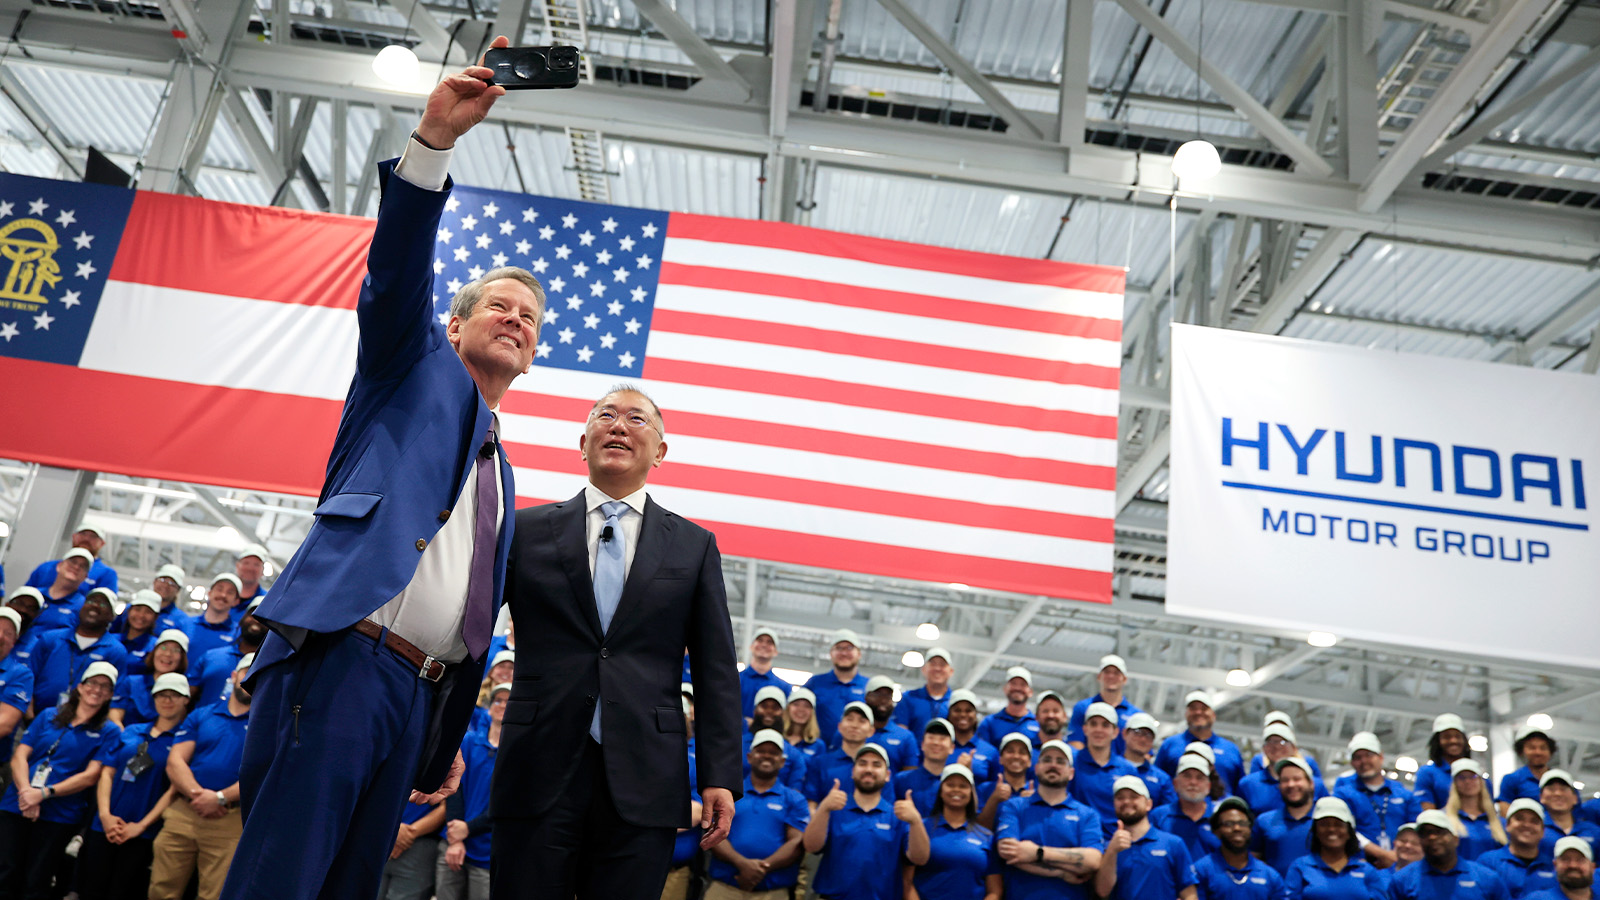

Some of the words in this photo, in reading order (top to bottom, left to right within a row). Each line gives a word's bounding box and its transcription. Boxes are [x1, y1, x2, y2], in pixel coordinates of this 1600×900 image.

[1221, 416, 1587, 510] HYUNDAI
[1262, 507, 1398, 547] MOTOR
[1415, 526, 1550, 564] GROUP
